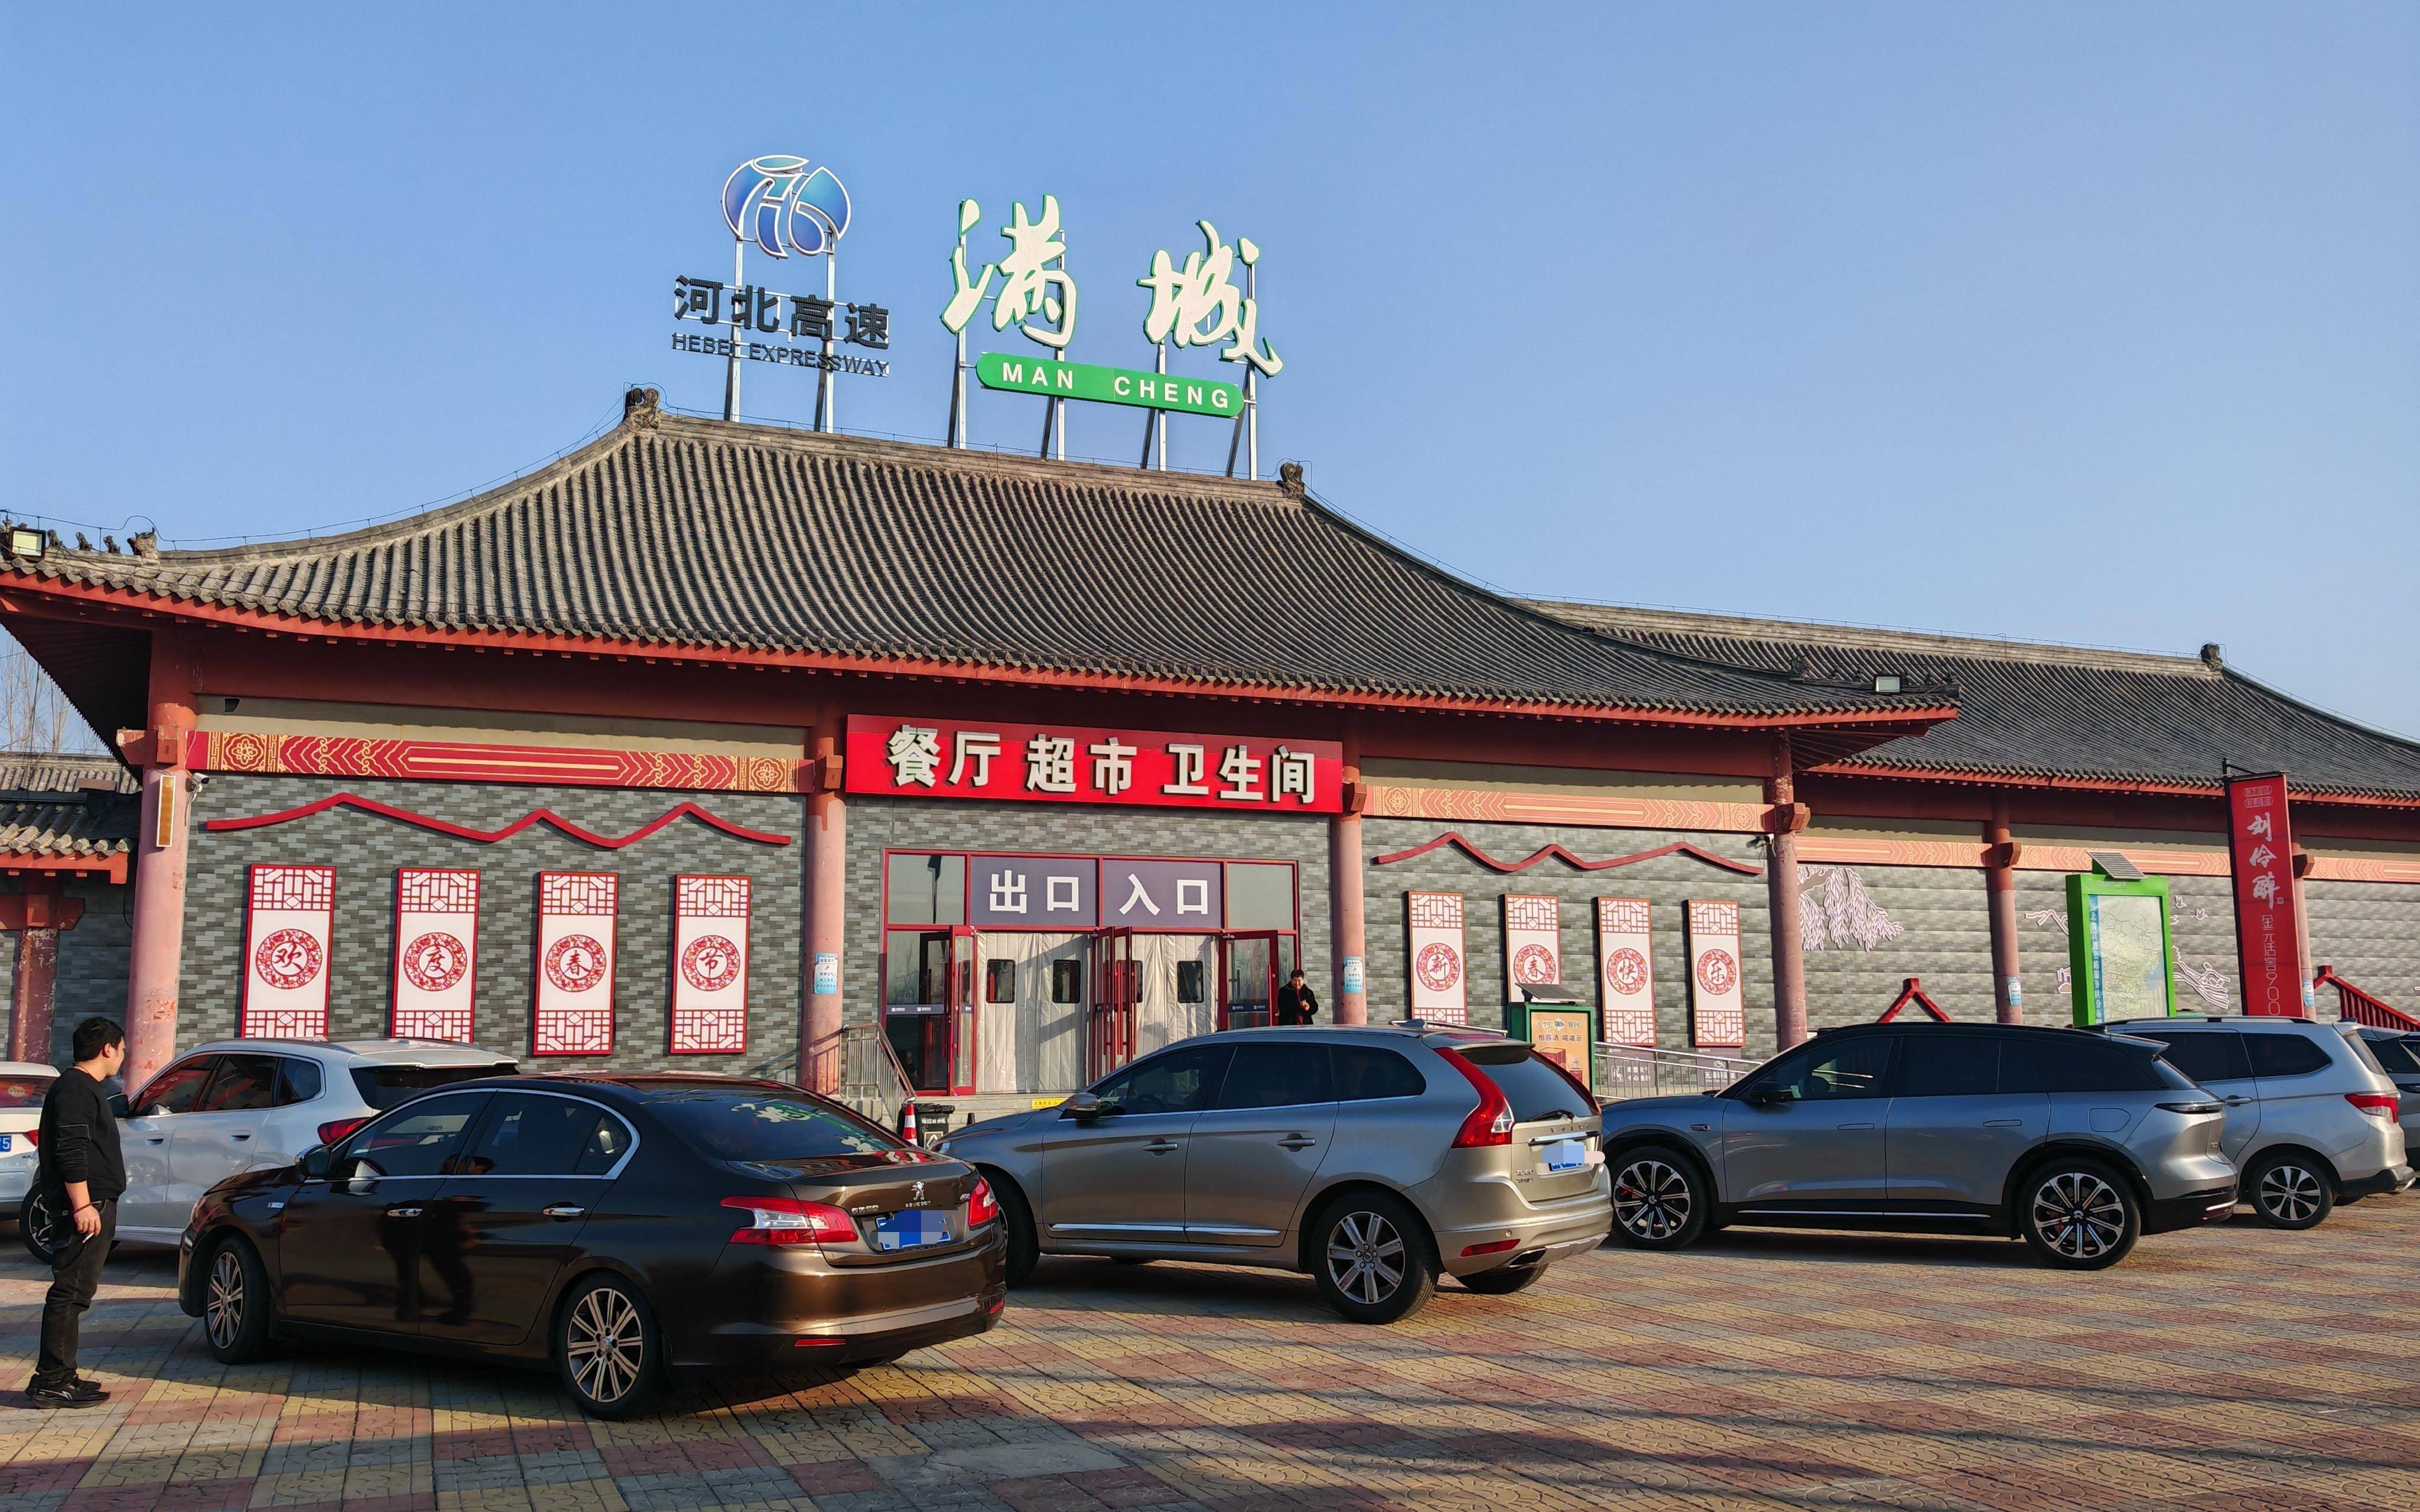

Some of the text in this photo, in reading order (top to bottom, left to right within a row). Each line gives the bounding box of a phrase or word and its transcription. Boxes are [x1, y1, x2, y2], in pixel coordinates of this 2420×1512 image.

[941, 193, 1284, 377] 满城
[674, 275, 889, 349] 河北高速
[672, 332, 889, 377] HEBEI EXPRESSWAY
[1003, 362, 1228, 409] MAN CHENG
[888, 724, 1315, 804] 餐厅 超市 卫生间
[990, 870, 1208, 916] 出口 入口
[272, 943, 304, 973] 欢
[424, 943, 446, 975] 度
[565, 950, 591, 976] 春
[699, 948, 723, 975] 节
[1429, 955, 1448, 978] 新
[1528, 956, 1544, 977] 春
[1619, 959, 1637, 982] 快
[1709, 959, 1725, 982] 乐
[0, 1138, 10, 1149] 5
